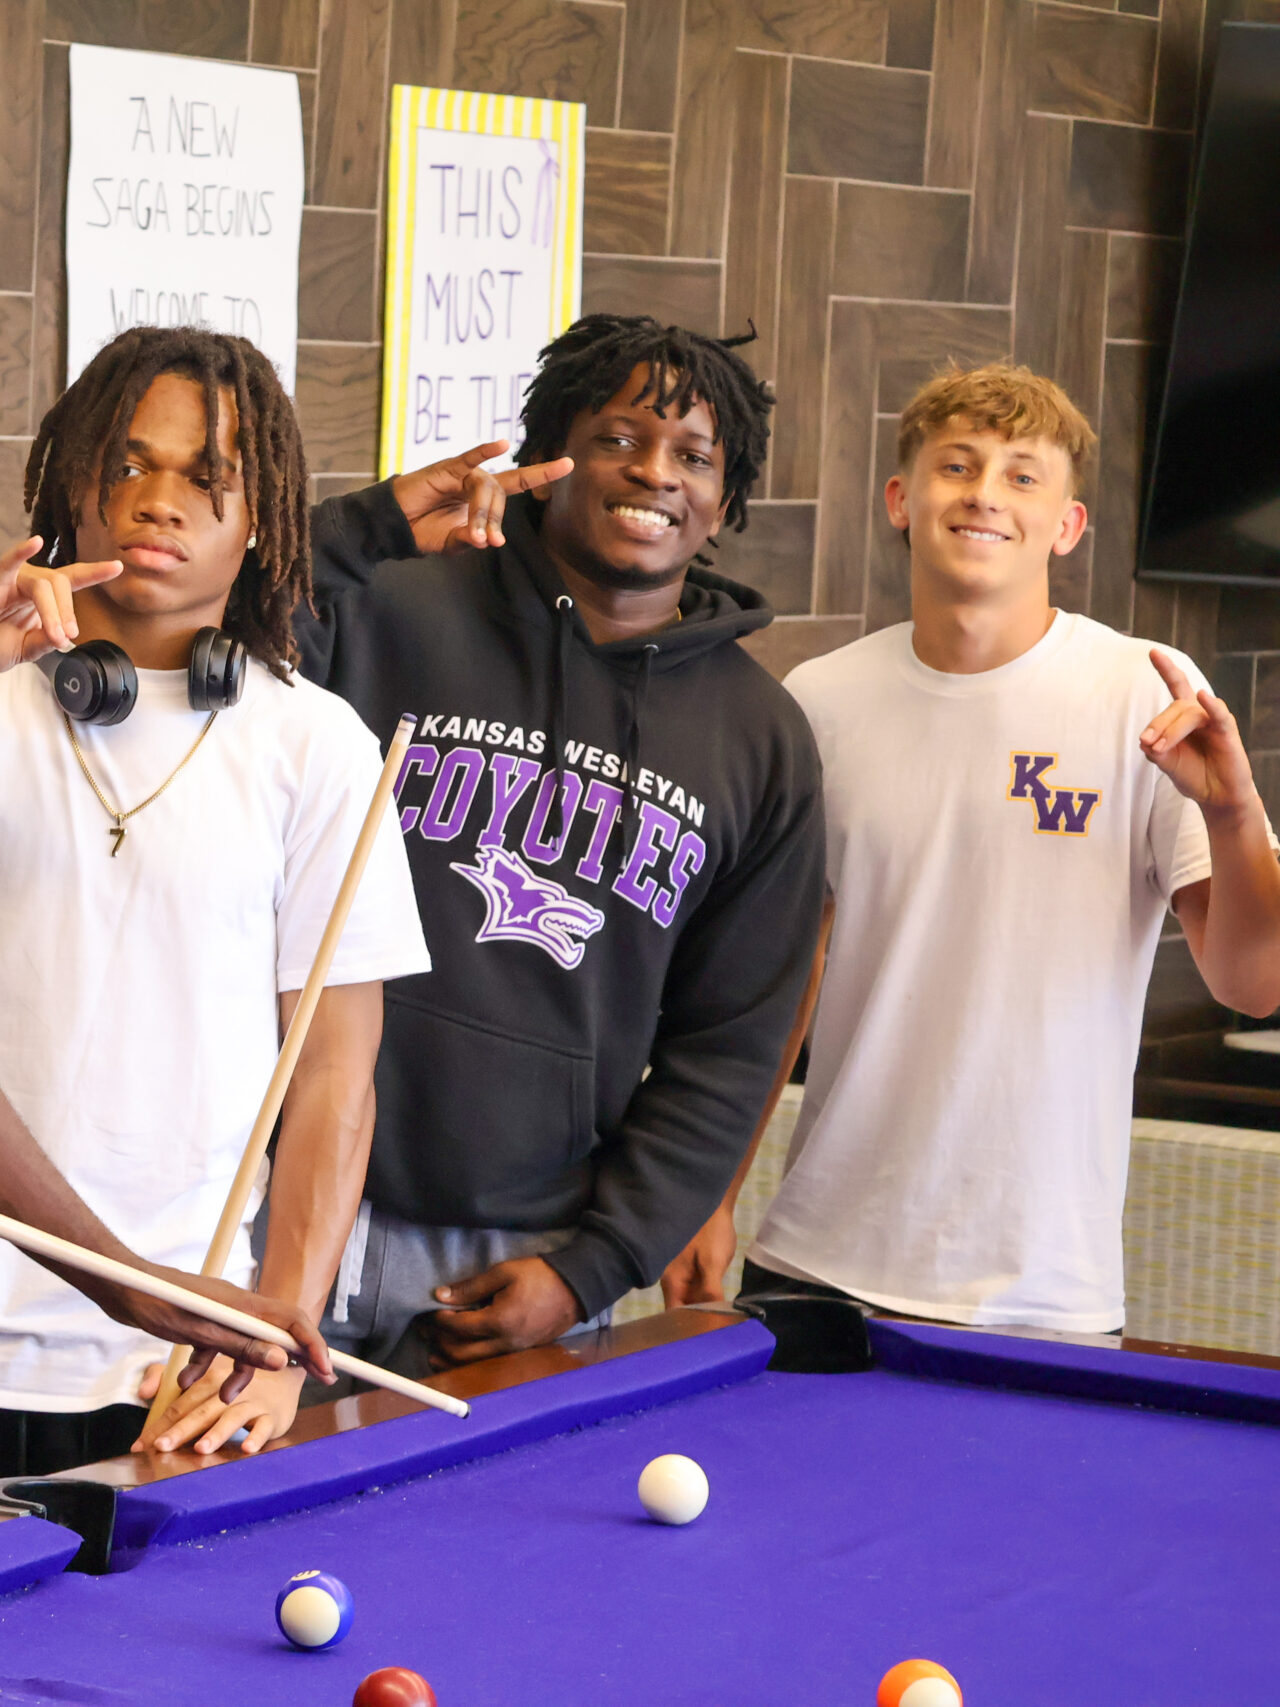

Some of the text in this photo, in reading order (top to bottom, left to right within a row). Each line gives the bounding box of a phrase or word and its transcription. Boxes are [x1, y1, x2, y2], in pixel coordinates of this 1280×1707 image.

[130, 94, 239, 159] A NEW
[86, 177, 275, 237] SAGA BEGINS
[429, 163, 523, 240] THIS
[423, 267, 523, 346] MUST
[414, 373, 454, 444] BE
[419, 713, 548, 755] KANSAS
